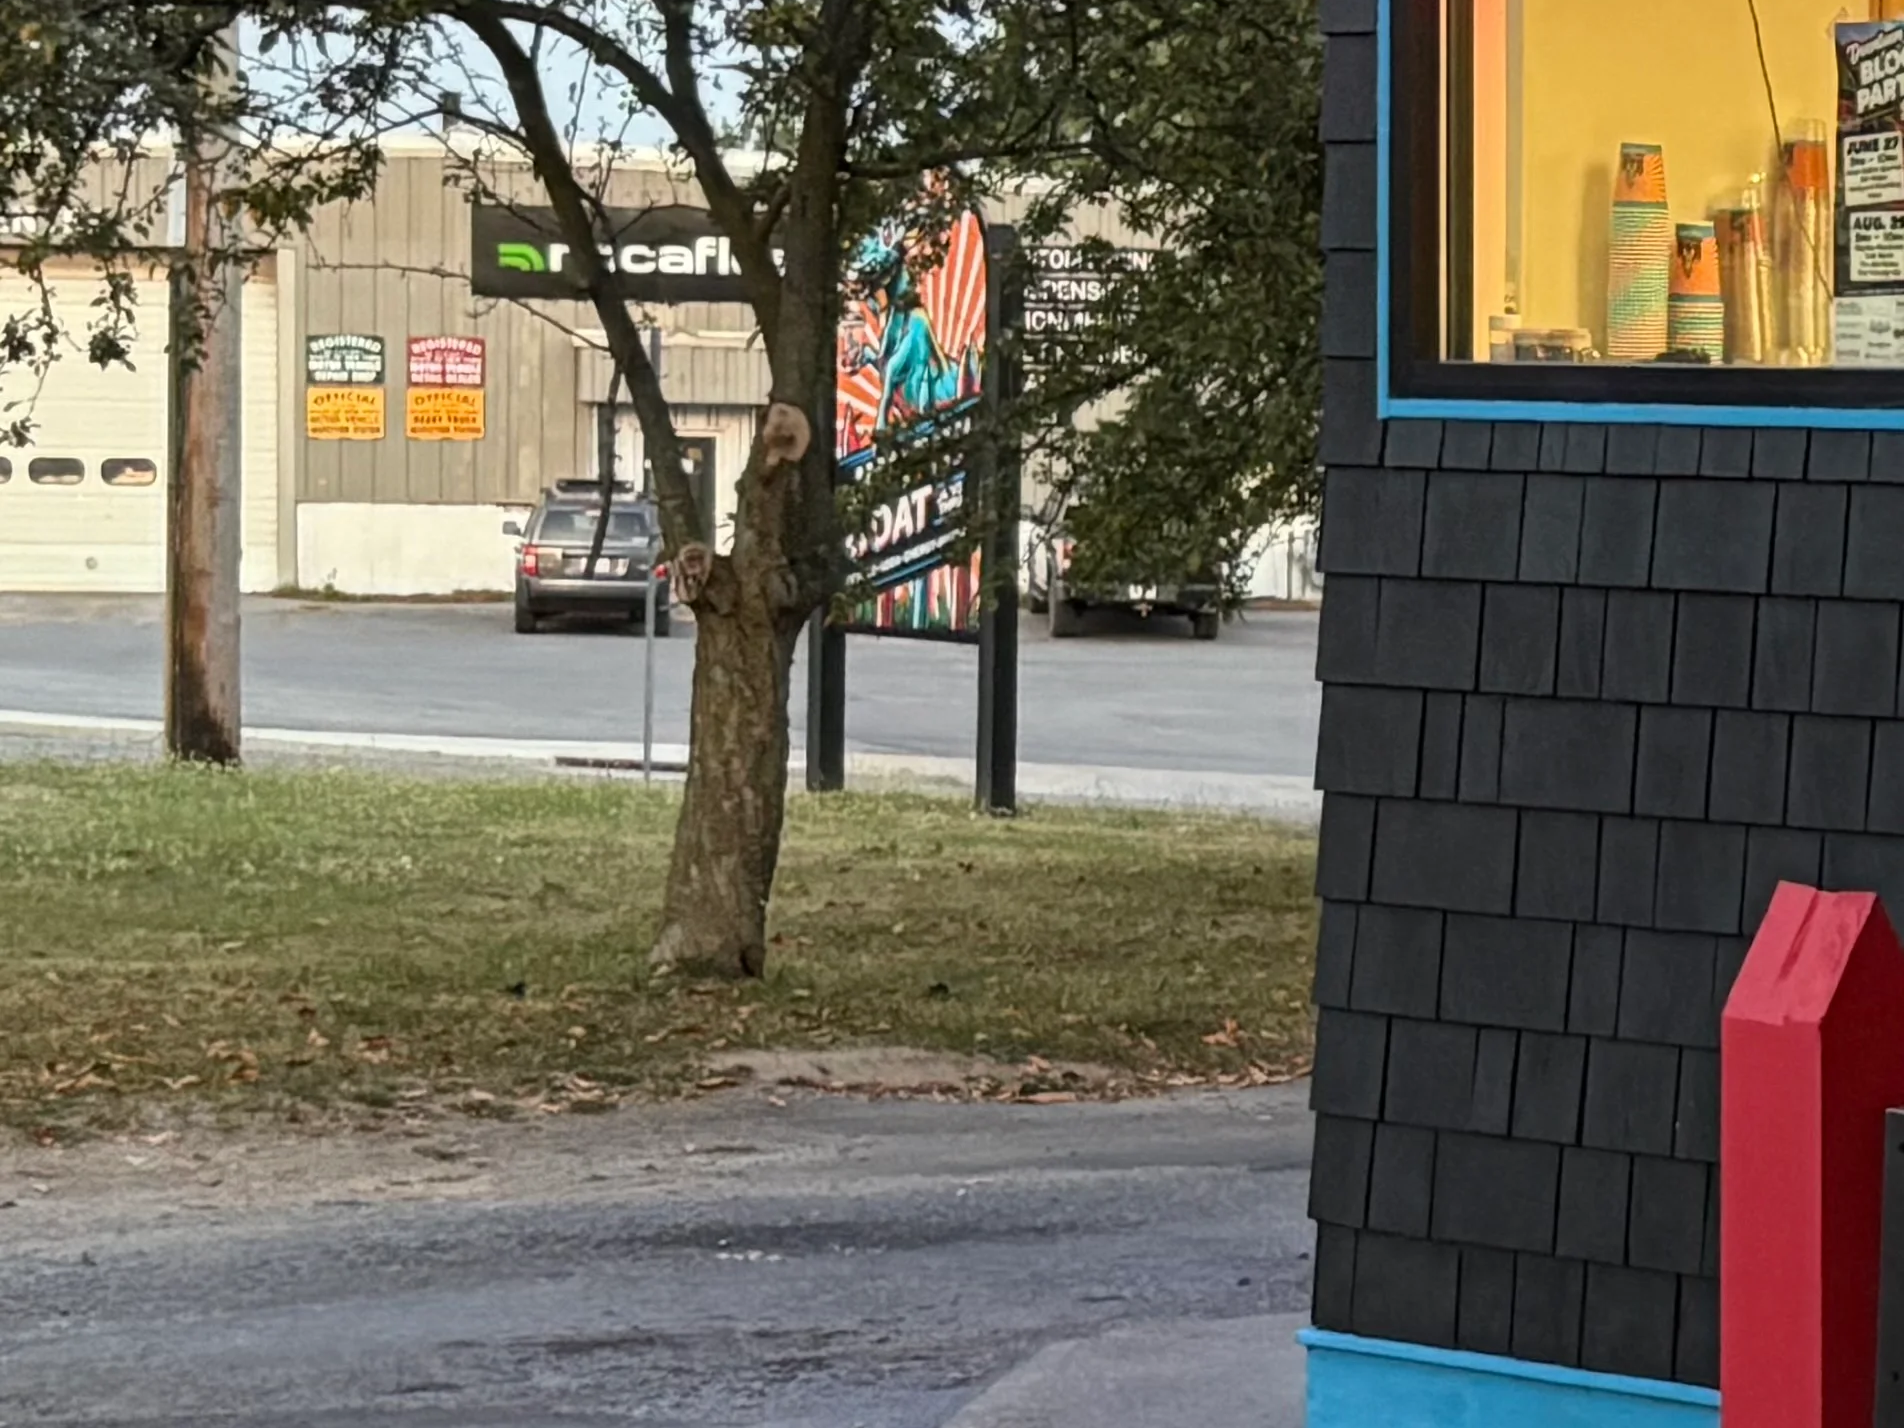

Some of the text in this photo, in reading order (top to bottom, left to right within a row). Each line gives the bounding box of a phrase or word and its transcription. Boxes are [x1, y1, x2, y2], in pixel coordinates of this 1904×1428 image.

[1847, 138, 1880, 155] JUNE
[313, 391, 376, 405] OFFICIAL
[414, 391, 476, 406] OFFICIAL
